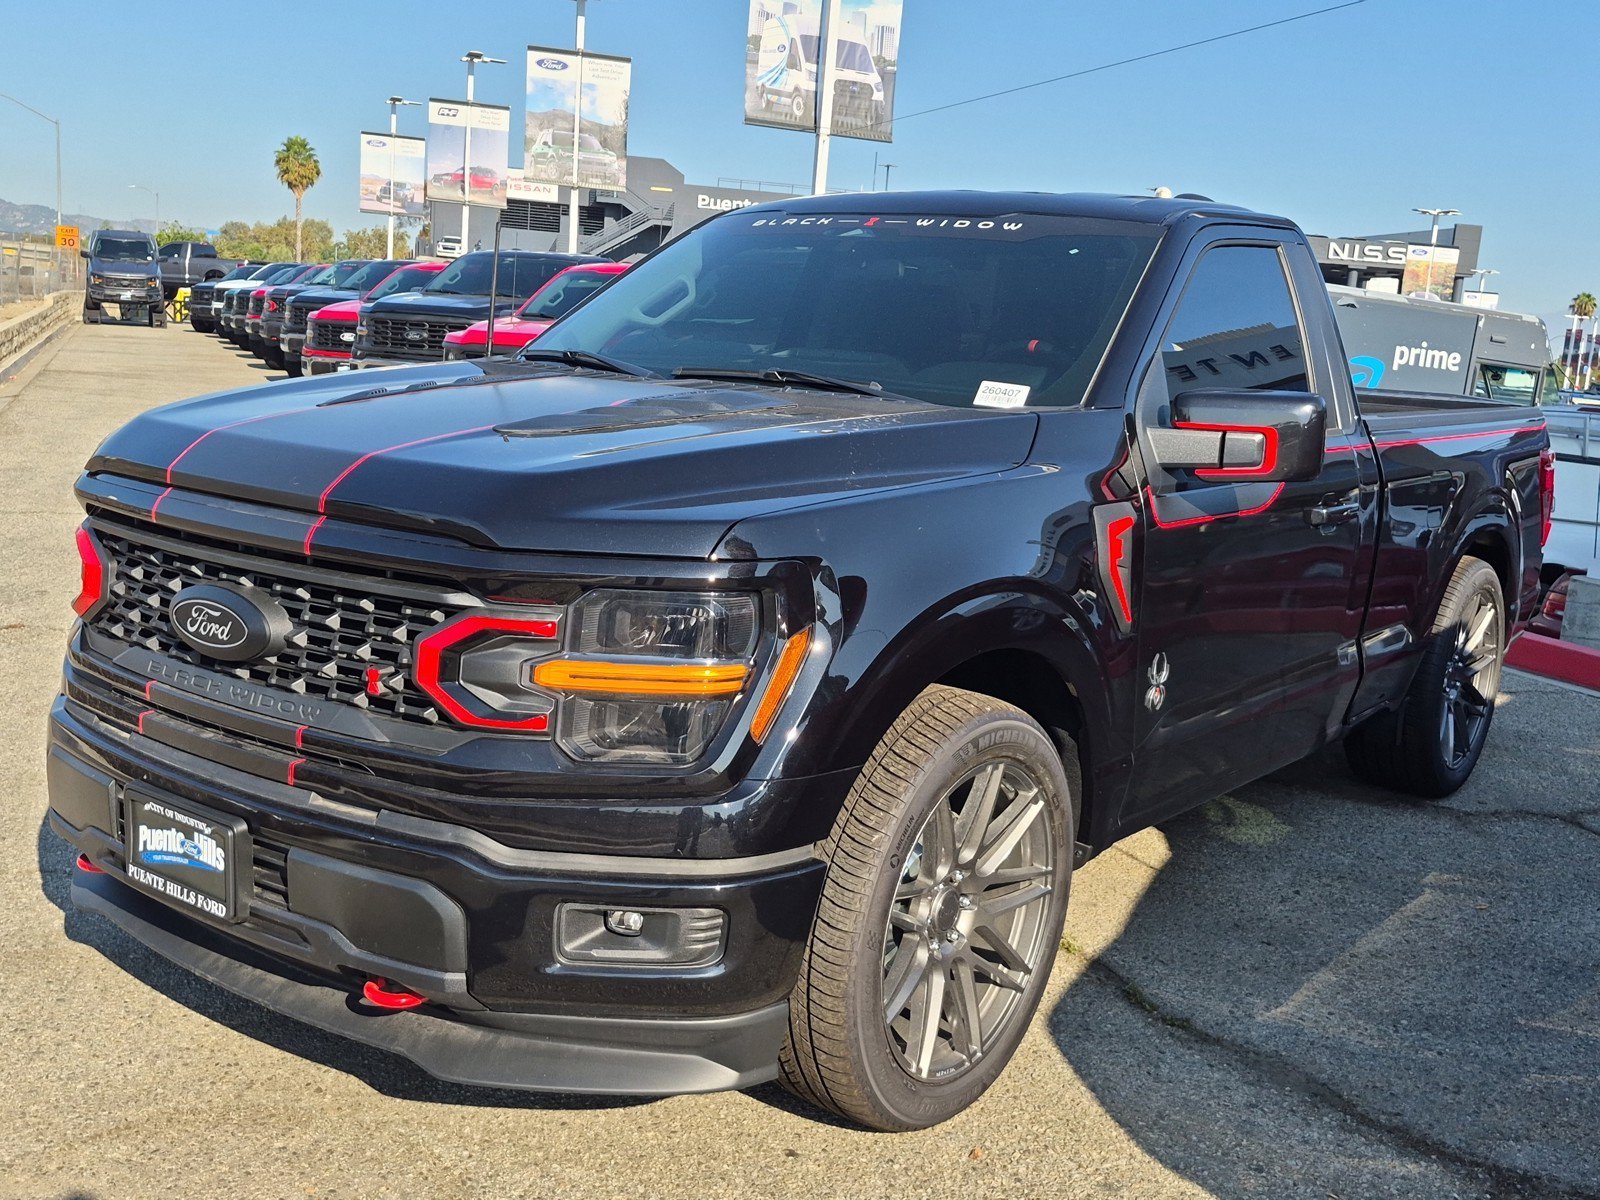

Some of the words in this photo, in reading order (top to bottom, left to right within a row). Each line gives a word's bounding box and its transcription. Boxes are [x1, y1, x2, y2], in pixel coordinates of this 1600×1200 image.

[541, 59, 564, 71] Ford
[509, 183, 551, 194] ISSAN
[697, 194, 759, 210] Puent
[752, 217, 833, 227] BLACK
[916, 218, 1023, 231] WIDOW
[60, 237, 75, 247] 30
[1328, 241, 1407, 265] NISS
[1392, 341, 1461, 371] prime
[981, 385, 1021, 397] 260407
[187, 605, 232, 641] Ford
[147, 659, 223, 695] BLACK
[229, 685, 323, 721] WIDOW
[978, 729, 1038, 752] MICHELIN
[149, 801, 165, 815] CITY
[164, 808, 174, 819] OF
[174, 811, 208, 832] INDUSTRY
[896, 814, 915, 851] MICHELIN
[138, 824, 186, 854] Puente
[193, 831, 226, 872] Hills
[128, 863, 165, 892] PUENTE
[165, 881, 197, 906] HILLS
[197, 893, 227, 918] FORD
